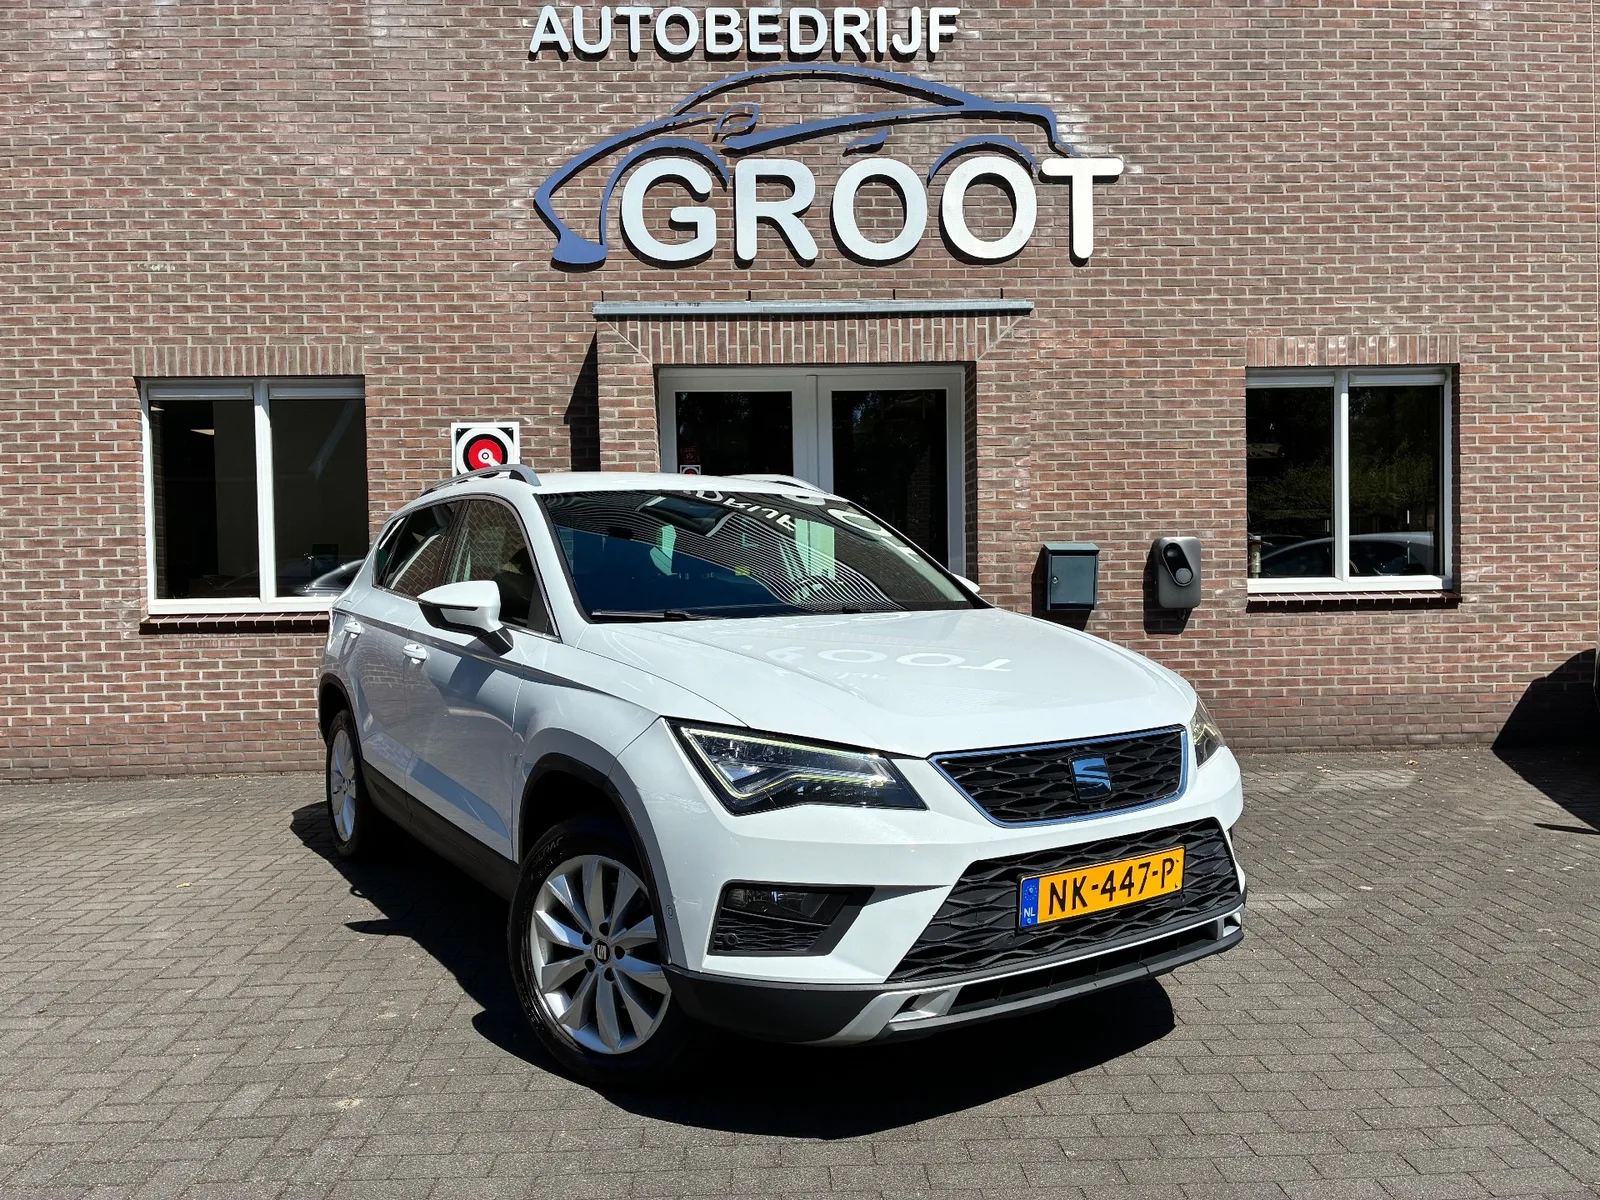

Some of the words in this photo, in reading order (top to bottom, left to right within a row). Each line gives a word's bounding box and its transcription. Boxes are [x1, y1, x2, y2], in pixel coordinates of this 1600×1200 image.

[529, 7, 961, 54] AUTOBEDRIJF
[621, 158, 1124, 262] GROOT
[1023, 906, 1036, 918] NL
[1048, 857, 1175, 915] NK-447-P
